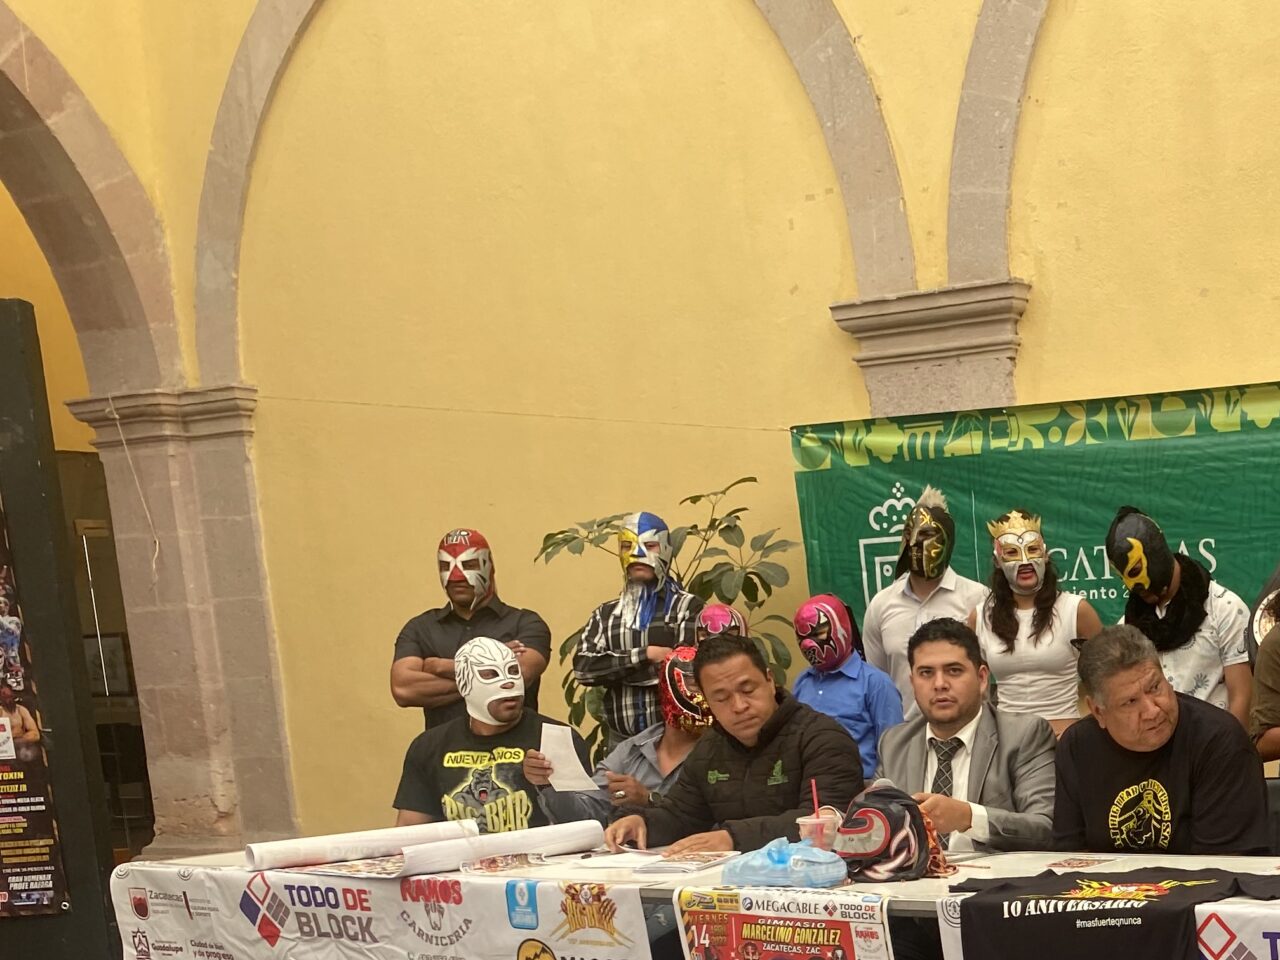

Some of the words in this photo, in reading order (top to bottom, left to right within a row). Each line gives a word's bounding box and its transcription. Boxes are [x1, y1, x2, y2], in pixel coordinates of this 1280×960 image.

[284, 884, 340, 909] TODO
[342, 888, 373, 911] DE
[753, 899, 820, 915] MEGACABLE
[839, 903, 863, 911] TODO
[840, 911, 877, 921] BLOCK
[1002, 900, 1022, 918] 10
[295, 911, 380, 944] BLOCK
[400, 909, 473, 947] CARNICERIA
[757, 918, 826, 928] GIMNASIO
[1075, 916, 1142, 929] #masfuerteqnunca
[691, 924, 710, 948] 14
[741, 922, 792, 943] MARCELINO
